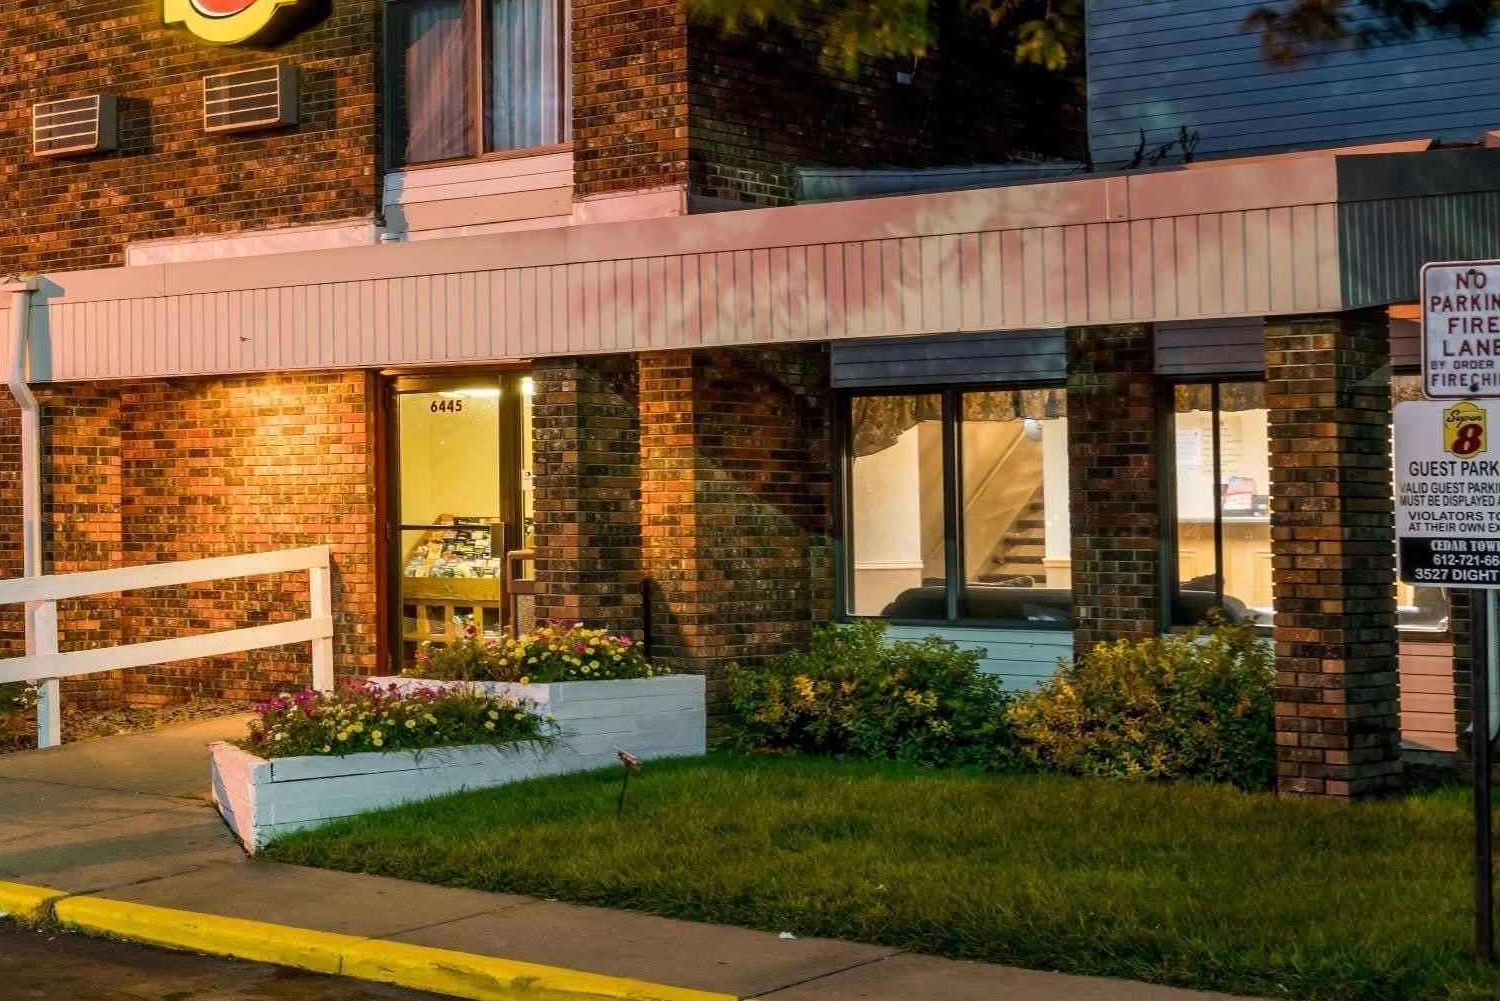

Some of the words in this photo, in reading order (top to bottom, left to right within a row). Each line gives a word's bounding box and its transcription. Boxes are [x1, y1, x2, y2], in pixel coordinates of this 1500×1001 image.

[1456, 271, 1487, 289] NO
[1448, 316, 1500, 334] FIRE
[1443, 339, 1500, 356] LANE
[1430, 361, 1446, 370] BY
[1453, 360, 1494, 369] ORDER
[1431, 373, 1500, 387] FIRECHI
[431, 400, 462, 412] 6445
[1446, 409, 1482, 428] Super
[1451, 424, 1483, 455] 8
[1409, 461, 1457, 476] GUEST
[1400, 482, 1428, 494] VALID
[1431, 482, 1465, 494] GUEST
[1468, 482, 1500, 494] PARKI
[1400, 495, 1426, 506] MUST
[1428, 495, 1440, 506] BE
[1443, 495, 1495, 506] DISPLAYED
[1408, 511, 1484, 521] VIOLATORS
[1408, 523, 1421, 532] AT
[1424, 523, 1456, 532] THEIR
[1459, 523, 1485, 532] OWN
[1430, 540, 1468, 551] CEDAR
[1433, 554, 1500, 567] 612-721-66
[1415, 568, 1449, 580] 3527
[1452, 569, 1499, 581] DIGHT
